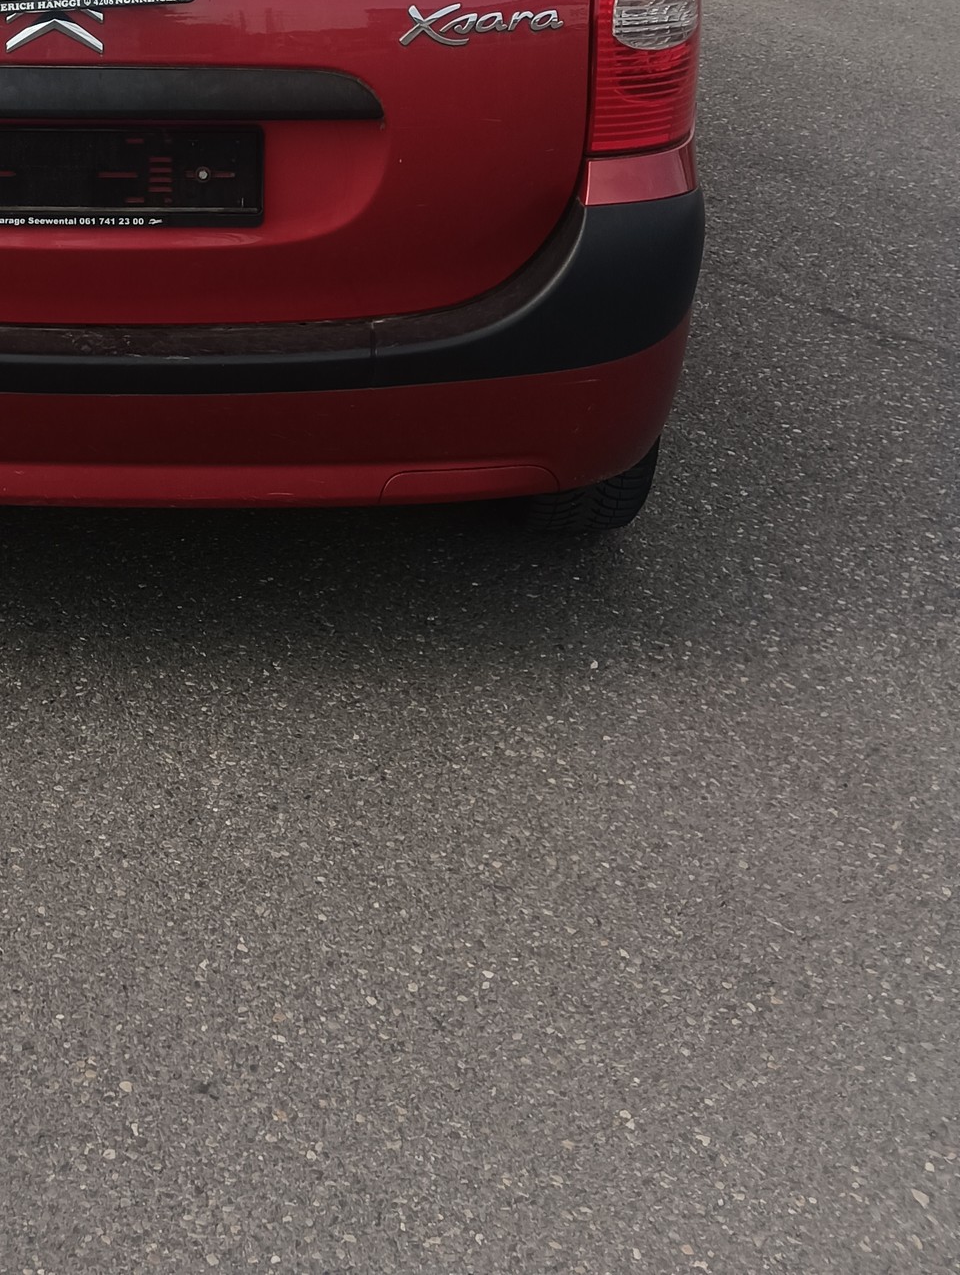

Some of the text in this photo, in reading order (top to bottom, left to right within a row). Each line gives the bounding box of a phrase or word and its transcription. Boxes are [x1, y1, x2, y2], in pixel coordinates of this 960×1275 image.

[0, 1, 35, 13] ERICH
[399, 3, 564, 46] Xsara
[27, 216, 77, 226] Seewental
[79, 217, 96, 225] 061
[99, 217, 116, 225] 741
[118, 217, 130, 225] 23
[132, 217, 145, 225] 00
